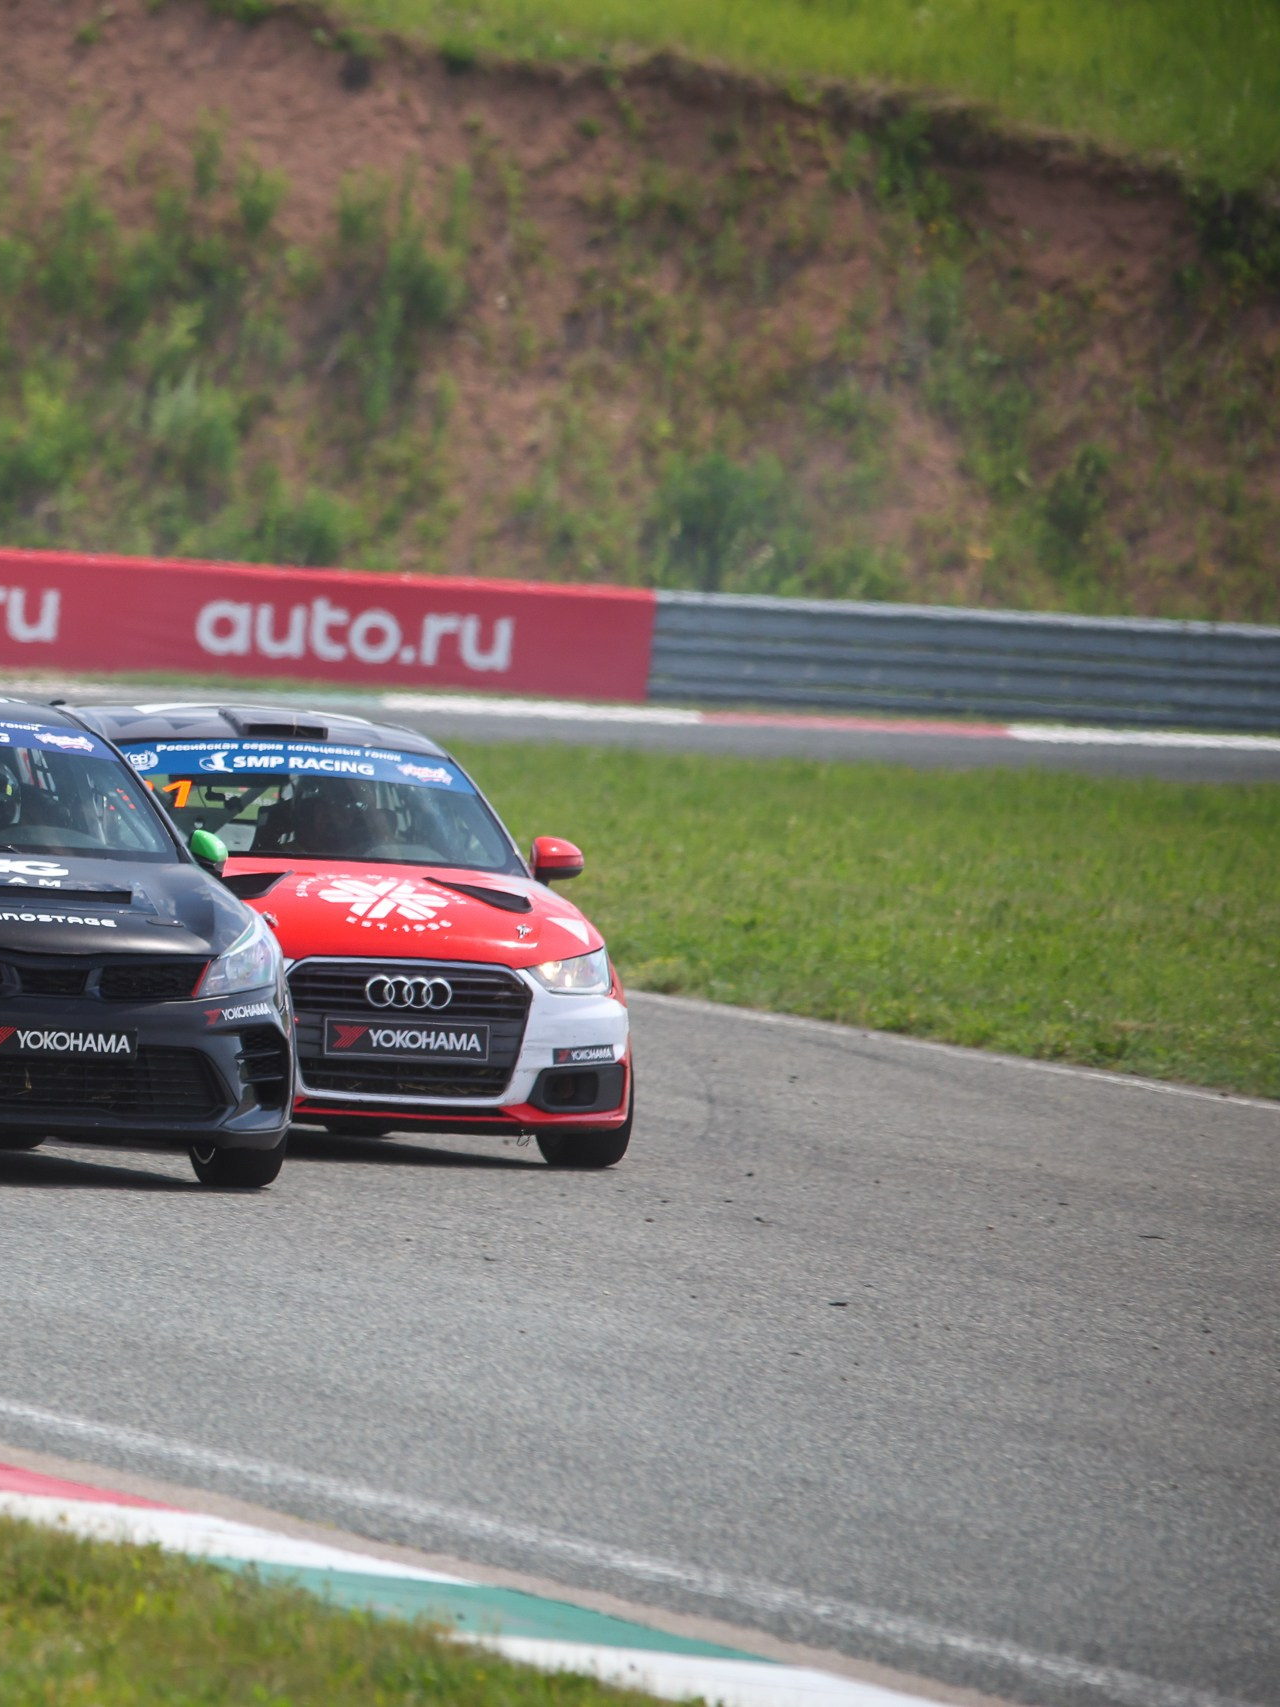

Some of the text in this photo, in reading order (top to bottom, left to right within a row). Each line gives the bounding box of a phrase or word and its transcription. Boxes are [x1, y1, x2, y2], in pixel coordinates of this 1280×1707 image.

[196, 598, 514, 672] auto.ru
[156, 743, 238, 752] Российская
[233, 756, 375, 776] SMP RACING
[221, 1003, 271, 1021] YOKOHAMA
[16, 1029, 131, 1054] YOKOHAMA
[368, 1027, 481, 1052] YOKOHAMA
[570, 1047, 612, 1061] YOKOHAMA
